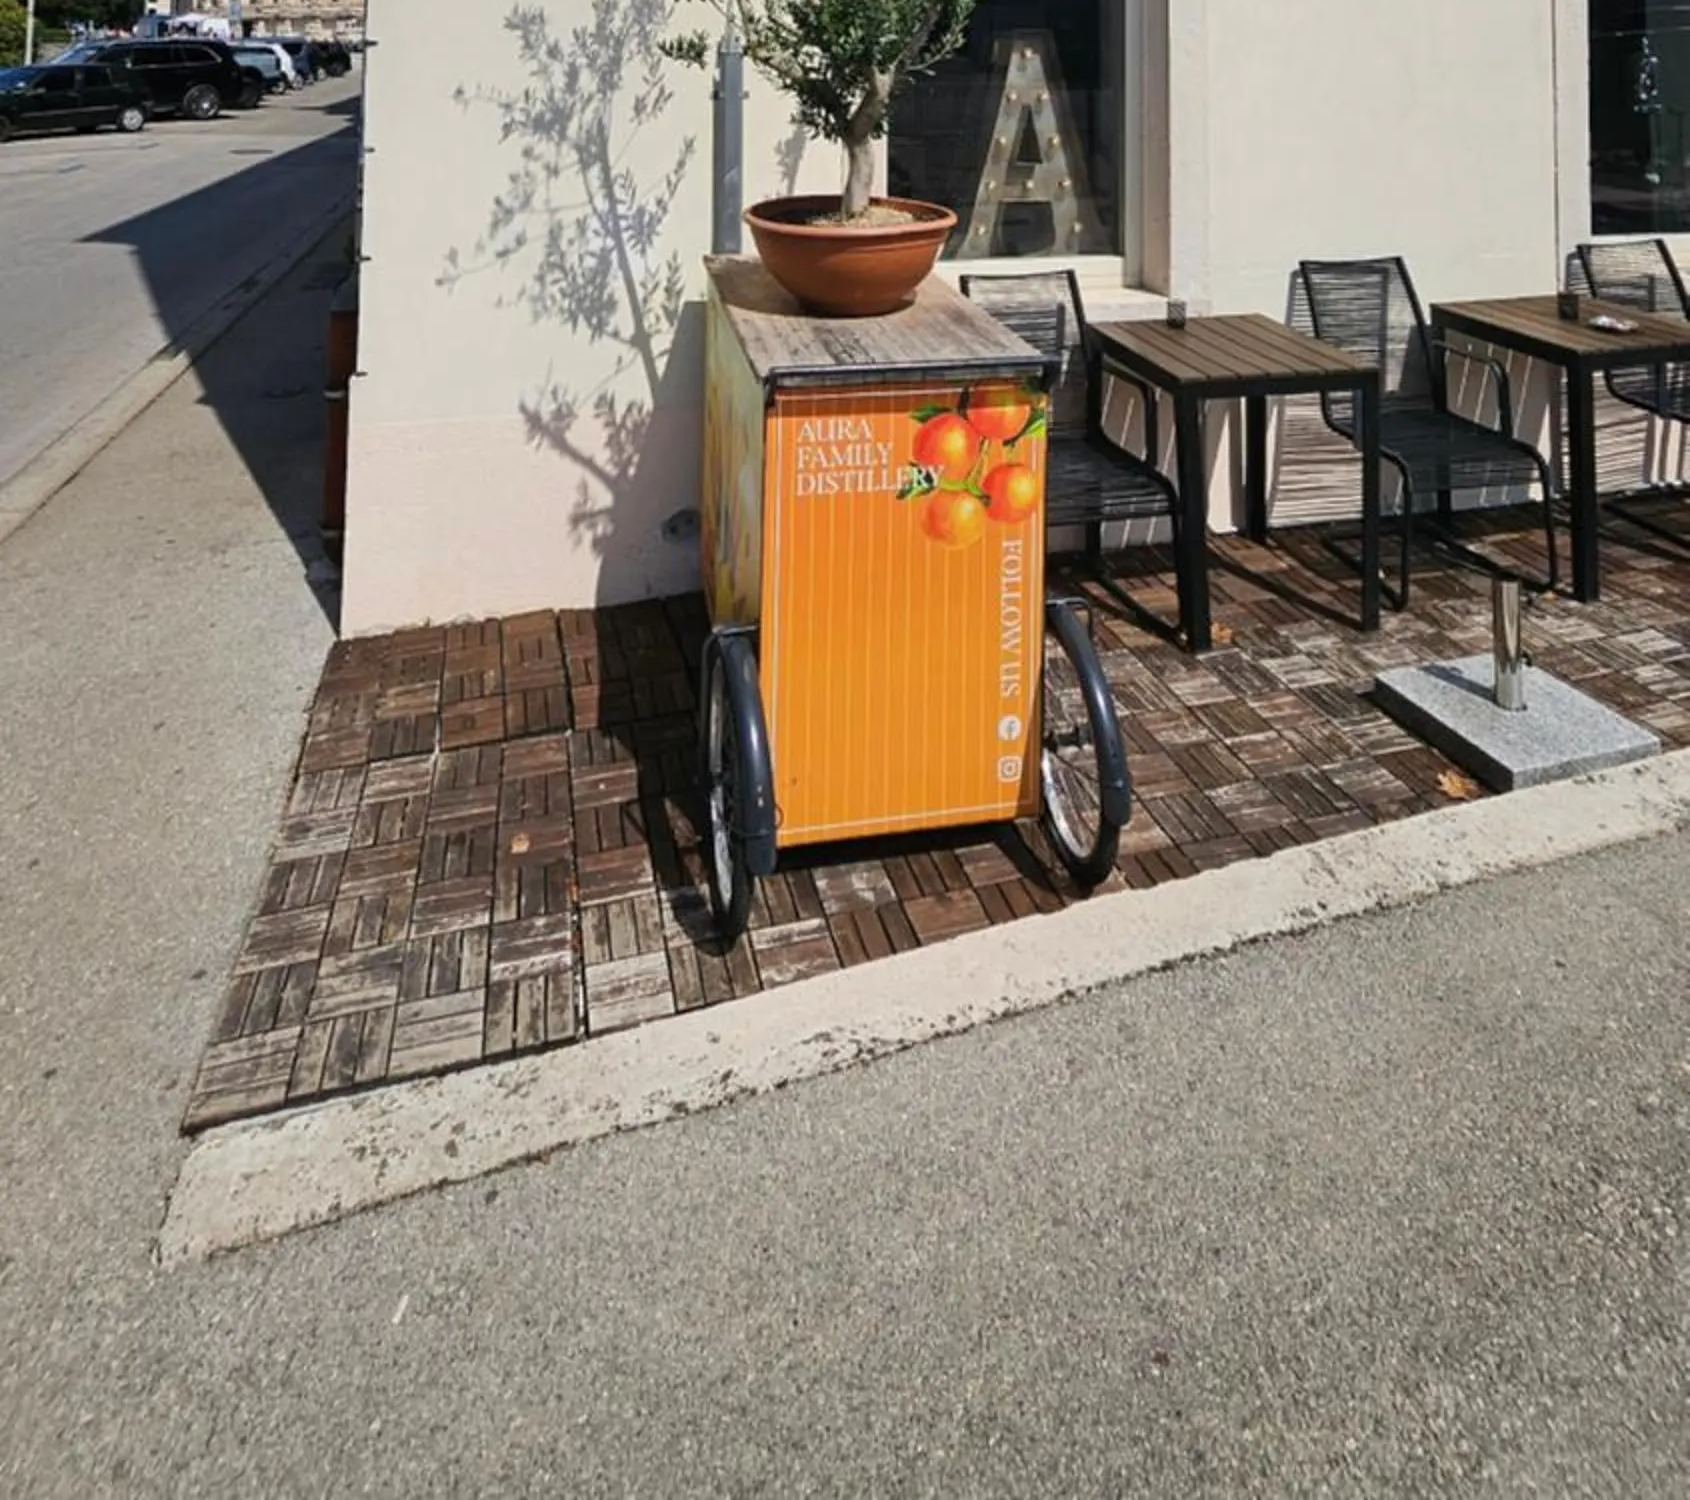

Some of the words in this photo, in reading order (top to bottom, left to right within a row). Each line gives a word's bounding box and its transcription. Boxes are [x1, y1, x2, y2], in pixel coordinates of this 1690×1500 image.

[957, 28, 1108, 258] A
[798, 419, 872, 442] AURA
[798, 443, 891, 469] FAMILY
[797, 466, 942, 495] DISTILLERY
[1001, 539, 1023, 652] FOLLOW
[1001, 656, 1021, 698] US
